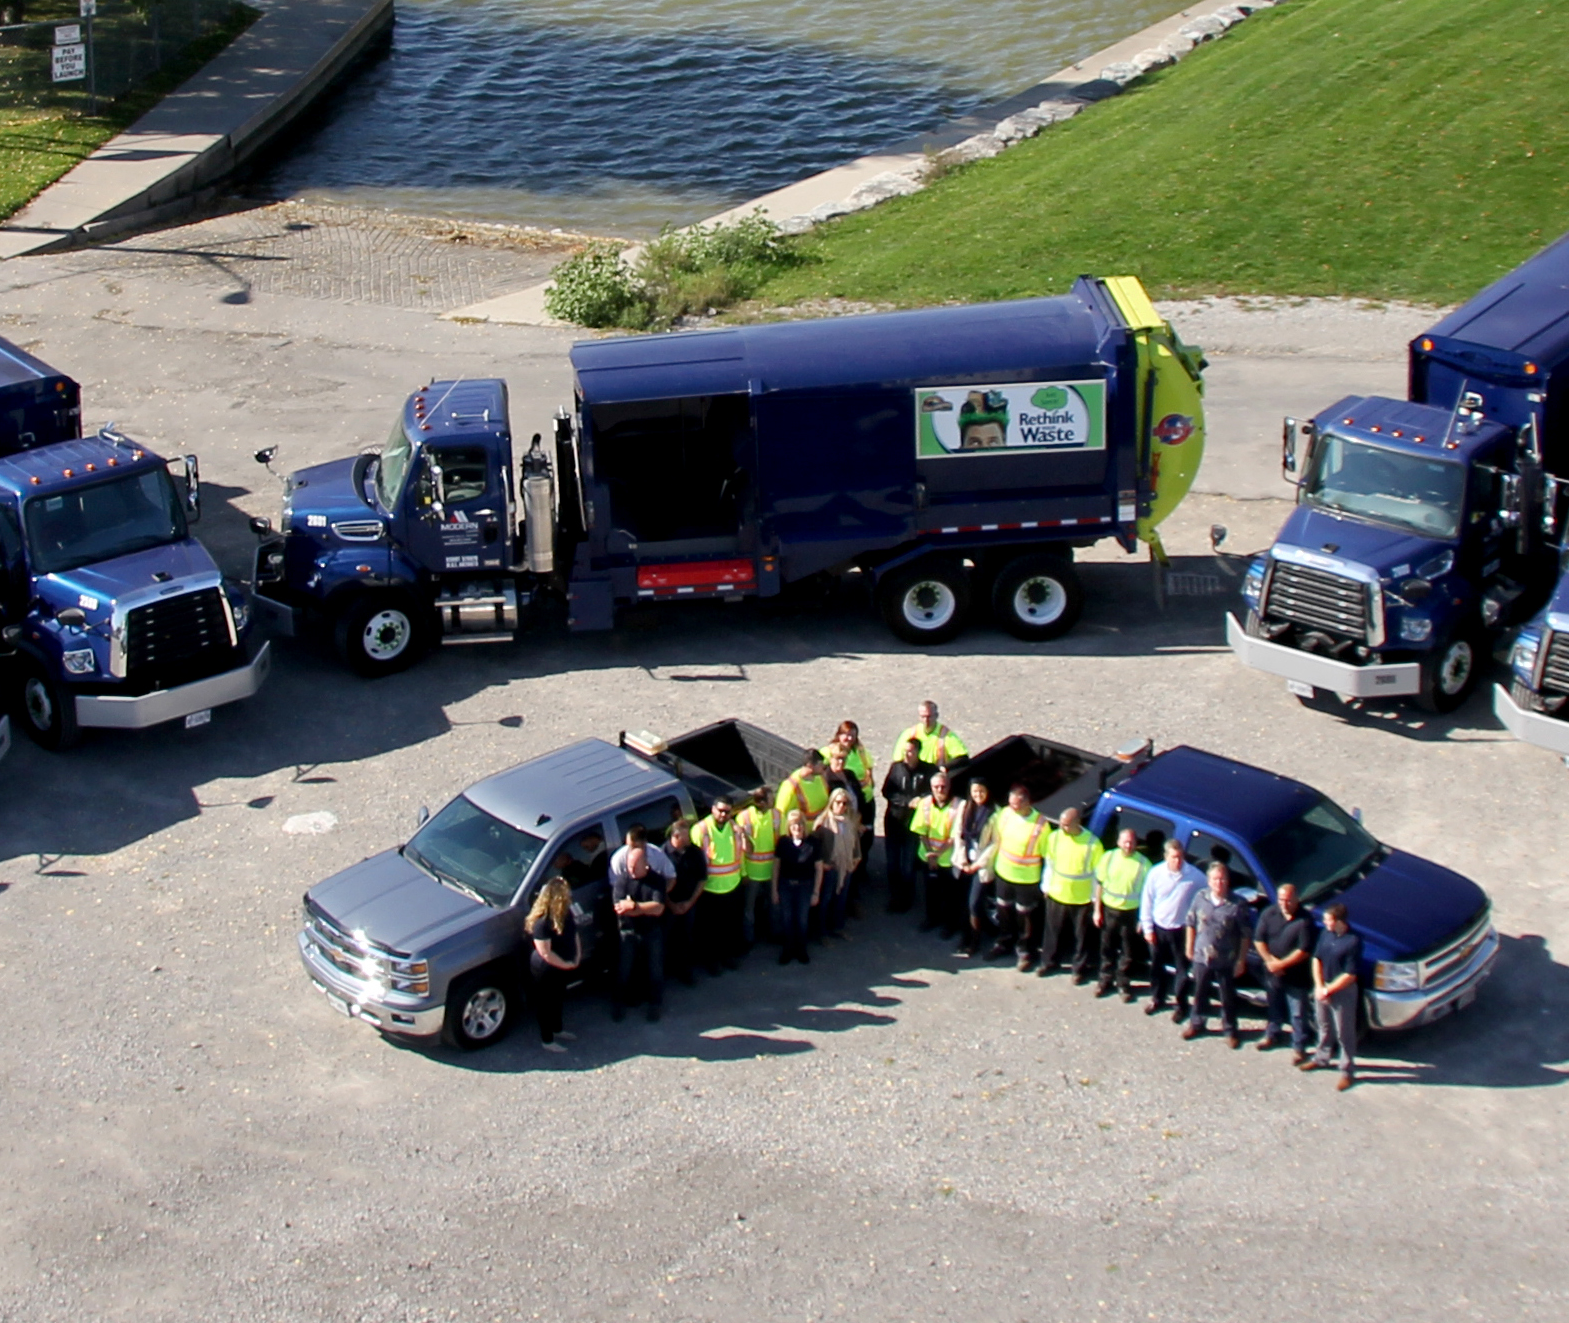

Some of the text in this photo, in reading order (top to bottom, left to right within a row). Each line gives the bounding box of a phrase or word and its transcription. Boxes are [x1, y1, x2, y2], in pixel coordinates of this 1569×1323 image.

[55, 54, 82, 64] BEFORE
[61, 62, 75, 70] YOU
[54, 68, 84, 79] LAUNCH
[1019, 410, 1075, 426] Rethink
[1019, 426, 1075, 444] Waste
[440, 522, 479, 532] MODERN
